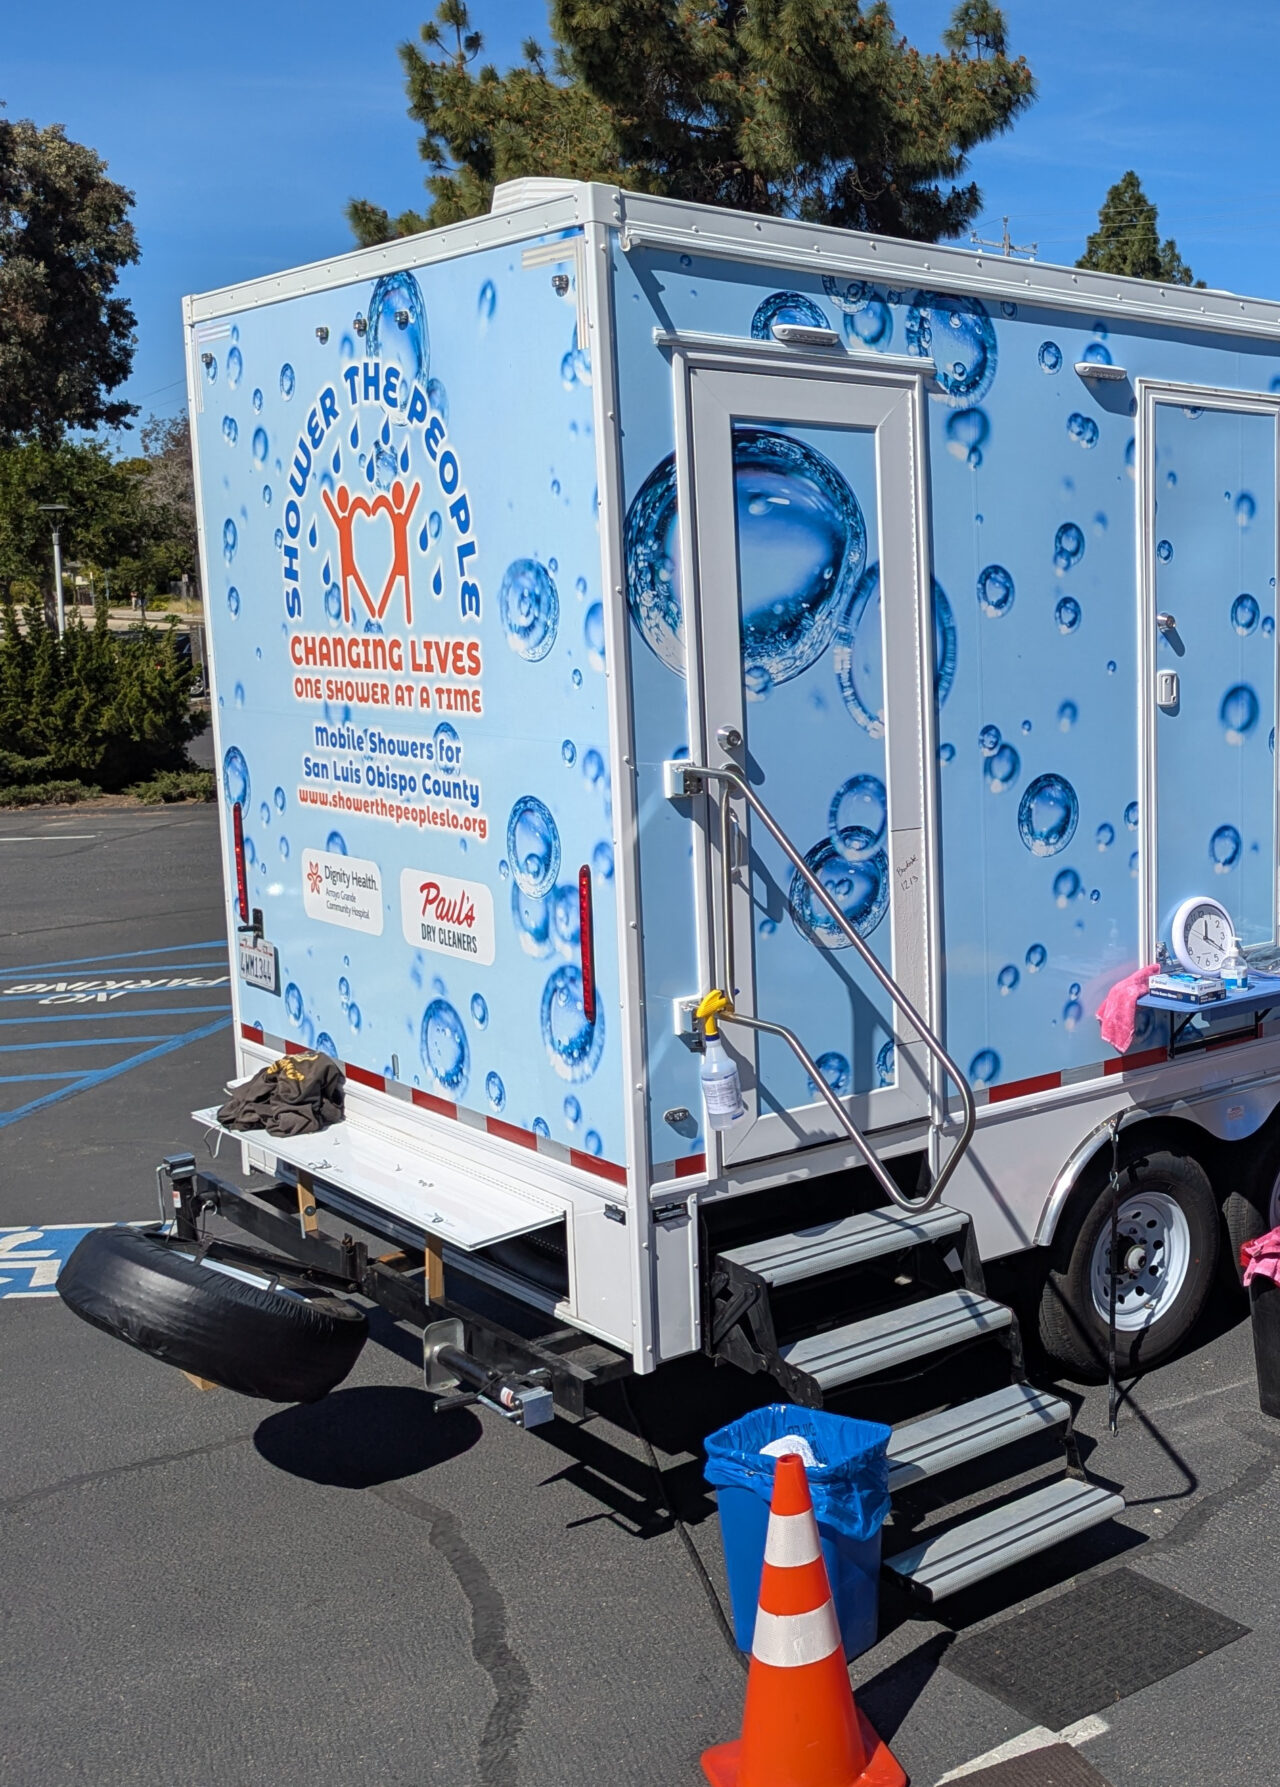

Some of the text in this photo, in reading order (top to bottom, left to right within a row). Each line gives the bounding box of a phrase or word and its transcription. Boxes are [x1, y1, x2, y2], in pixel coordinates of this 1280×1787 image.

[283, 362, 481, 619] SHOWER THE PEOPLE
[290, 635, 482, 676] CHANGING LIVES
[294, 677, 482, 713] ONE SHOWER AT A TIME
[314, 725, 462, 764] Mobile Showers for
[303, 756, 480, 808] San Luis Obispo County
[298, 787, 488, 839] www.showerthepeopleslo.org
[324, 865, 351, 889] Dignity
[326, 900, 371, 919] Community Hospital
[419, 881, 476, 929] Paul's
[1215, 920, 1221, 929] 2
[421, 922, 478, 954] DRY CLEANERS
[1220, 931, 1226, 941] 3
[1188, 946, 1194, 956] 8
[1196, 955, 1201, 965] 7
[1213, 953, 1220, 963] 5
[1205, 957, 1211, 967] 6
[3, 976, 232, 995] PARKING
[38, 991, 128, 1005] NO
